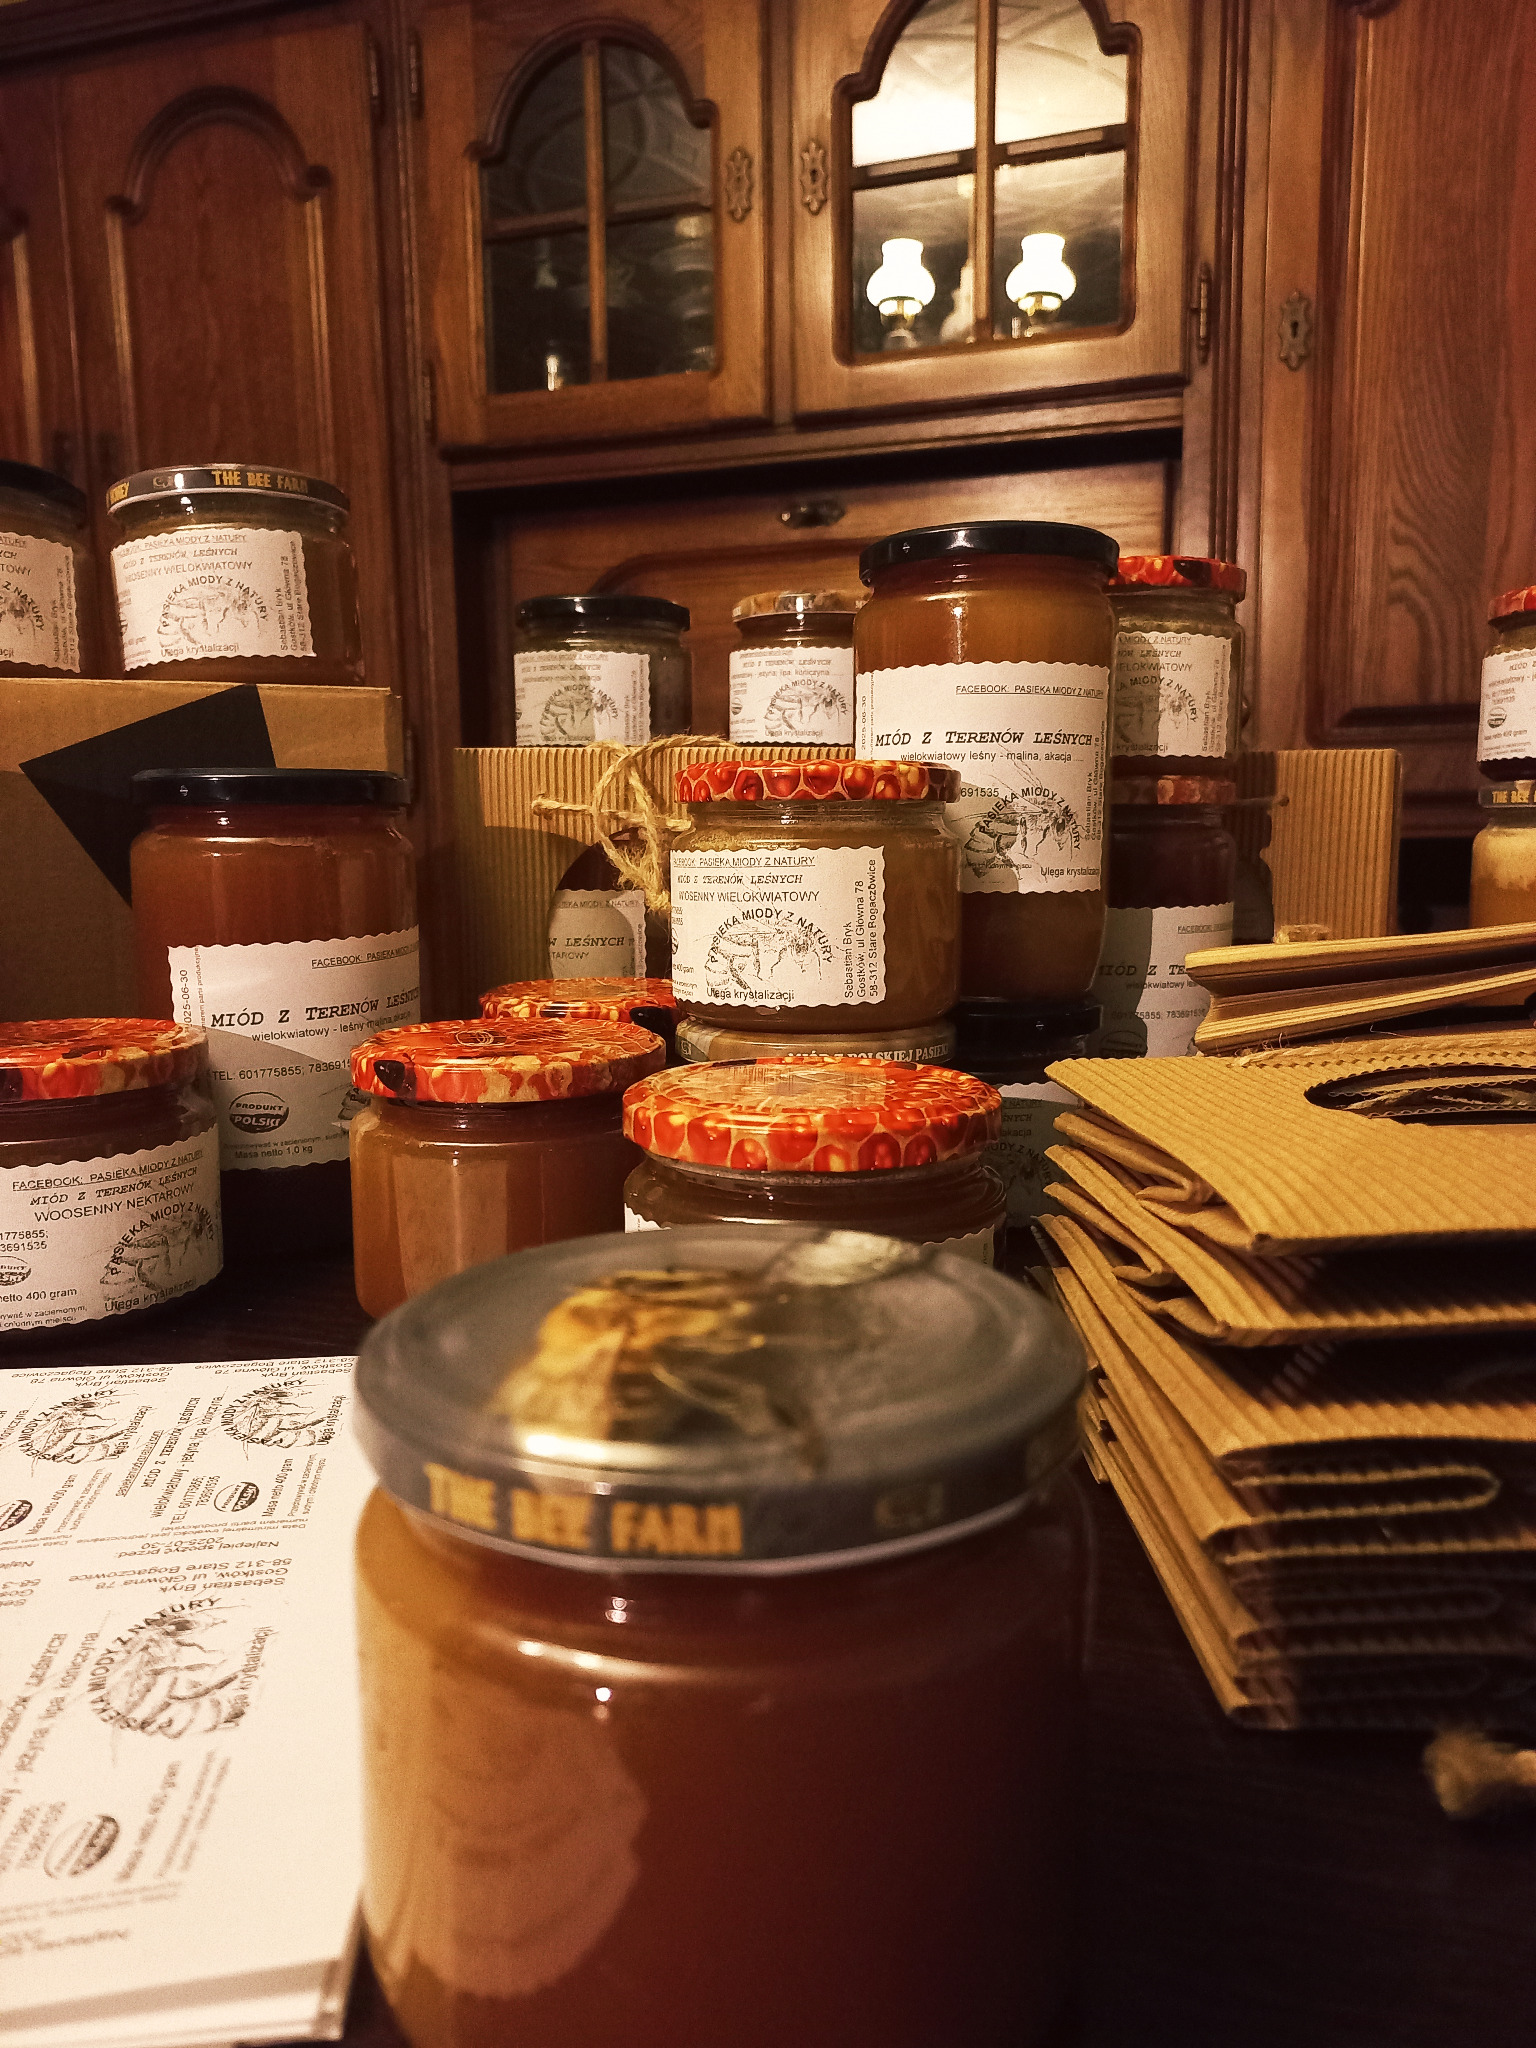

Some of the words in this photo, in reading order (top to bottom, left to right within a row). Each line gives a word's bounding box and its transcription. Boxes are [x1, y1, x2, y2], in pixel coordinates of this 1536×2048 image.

[212, 471, 242, 486] THE
[247, 472, 271, 487] BEE
[193, 546, 238, 558] LEŚNYCH
[187, 574, 223, 587] MIODY
[1014, 685, 1051, 696] PASIEKA
[1052, 686, 1076, 696] MIODY
[875, 730, 911, 747] MIÓD
[922, 732, 935, 745] Z
[946, 728, 1024, 745] TERENÓW
[1033, 729, 1093, 745] LEŚNYCH
[901, 750, 966, 764] wielokwiatowy
[969, 748, 997, 764] leśny
[1044, 751, 1072, 763] akacja
[978, 792, 1020, 835] PASIEKA
[1020, 786, 1058, 801] MIODY
[765, 857, 771, 866] Z
[773, 856, 815, 867] NATURY
[750, 872, 803, 884] LEŚNYCH
[1041, 866, 1064, 879] Ulega
[854, 880, 864, 894] 78
[717, 890, 820, 903] WIELOKWIATOWY
[564, 933, 625, 947] LEŚNYCH
[710, 915, 741, 964] PASIEKA
[742, 907, 783, 921] MIODY
[784, 910, 795, 923] Z
[796, 915, 833, 964] NATURY
[842, 921, 854, 945] Bryk
[867, 931, 878, 959] Stare
[842, 948, 854, 999] Sebastian
[1147, 965, 1158, 977] Z
[868, 961, 878, 998] 58-312
[734, 985, 796, 1002] krystalizacji
[211, 1007, 264, 1027] MIÓD
[278, 1009, 291, 1024] Z
[305, 997, 380, 1020] TERENÓW
[251, 1025, 330, 1043] wielokwiatowy
[340, 1021, 366, 1034] leśny
[236, 1103, 284, 1111] PRODUKT
[233, 1117, 282, 1129] POLSKI
[235, 1150, 258, 1160] Masa
[261, 1148, 284, 1158] netto
[286, 1144, 300, 1156] 1,0
[302, 1144, 314, 1156] kg
[12, 1175, 84, 1190] FACEBOOK:
[89, 1168, 137, 1183] PASIEKA
[139, 1160, 169, 1177] MIODY
[30, 1189, 69, 1206] MIÓD
[77, 1191, 87, 1202] Z
[95, 1178, 153, 1199] TERENÓW
[34, 1200, 123, 1223] WOOSENNY
[126, 1182, 195, 1211] NEKTAROWY
[109, 1218, 150, 1277] PASIEKA
[149, 1203, 187, 1224] MIODY
[26, 1290, 47, 1301] 400
[49, 1287, 78, 1301] gram
[104, 1298, 140, 1312] Ulega
[610, 1500, 743, 1556] FARM
[219, 1540, 281, 1552] Najlepiej
[185, 1562, 231, 1573] Stare
[234, 1557, 293, 1569] 58-312
[67, 1564, 182, 1582] Bogaczowice
[158, 1582, 197, 1593] Bryk
[202, 1577, 287, 1590] Sebastian
